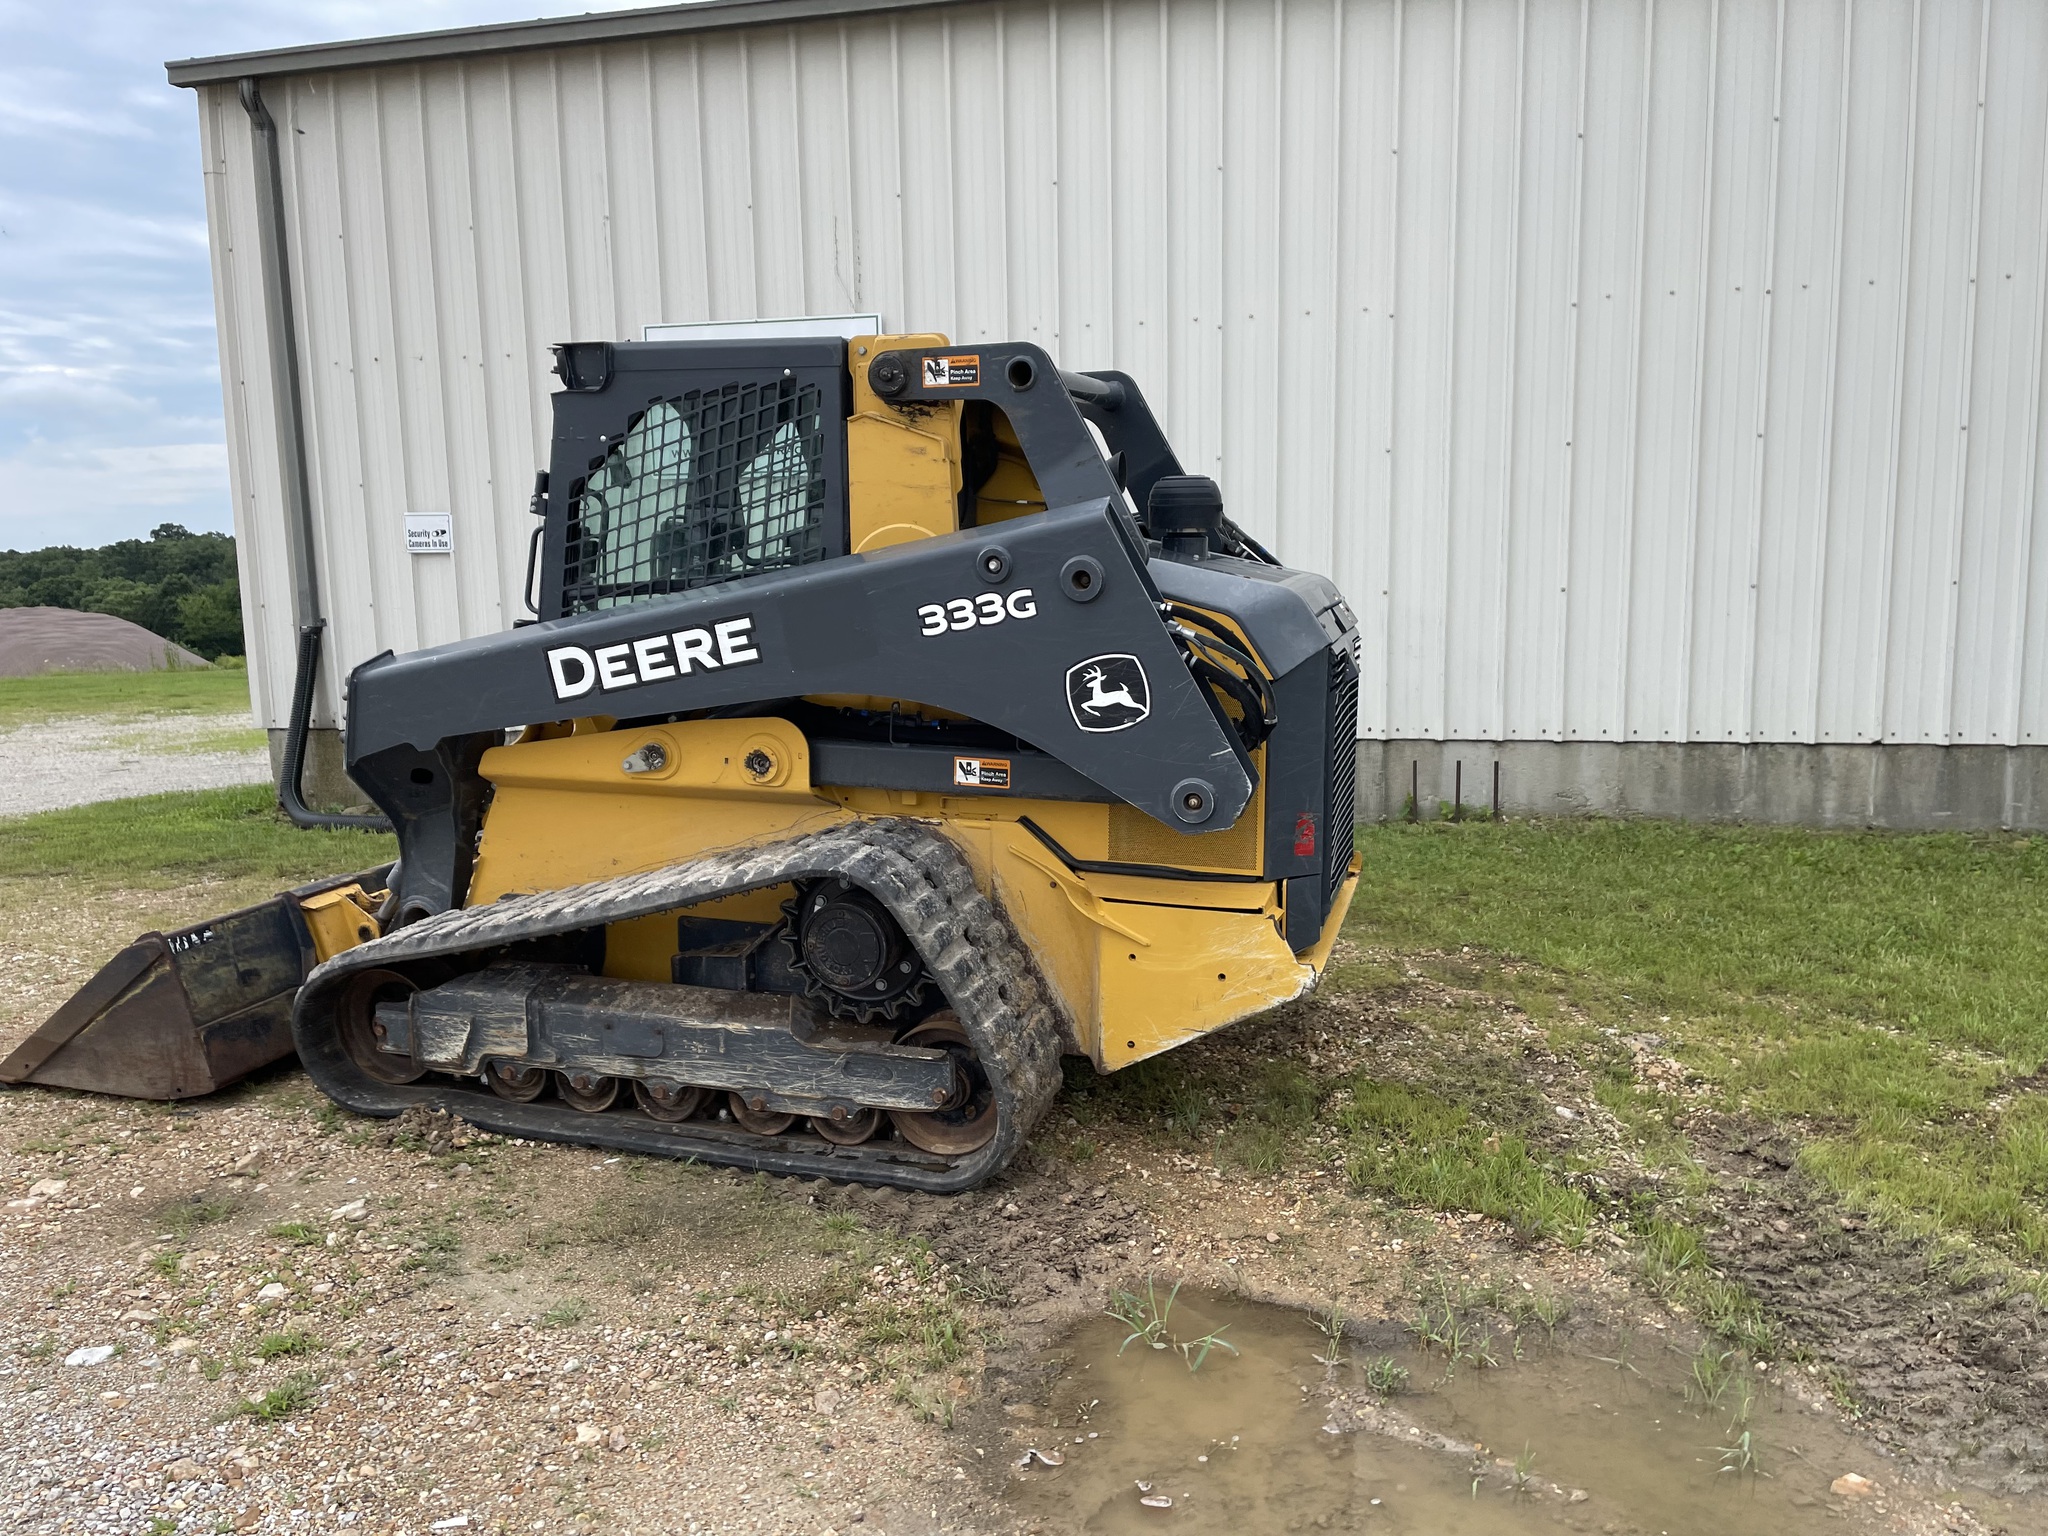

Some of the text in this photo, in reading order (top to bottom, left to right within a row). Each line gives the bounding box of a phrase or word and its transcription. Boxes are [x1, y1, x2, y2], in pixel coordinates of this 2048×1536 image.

[407, 528, 430, 539] Security
[408, 539, 448, 548] Cameras In Use
[917, 588, 1037, 637] 333G
[547, 617, 759, 699] DEERE
